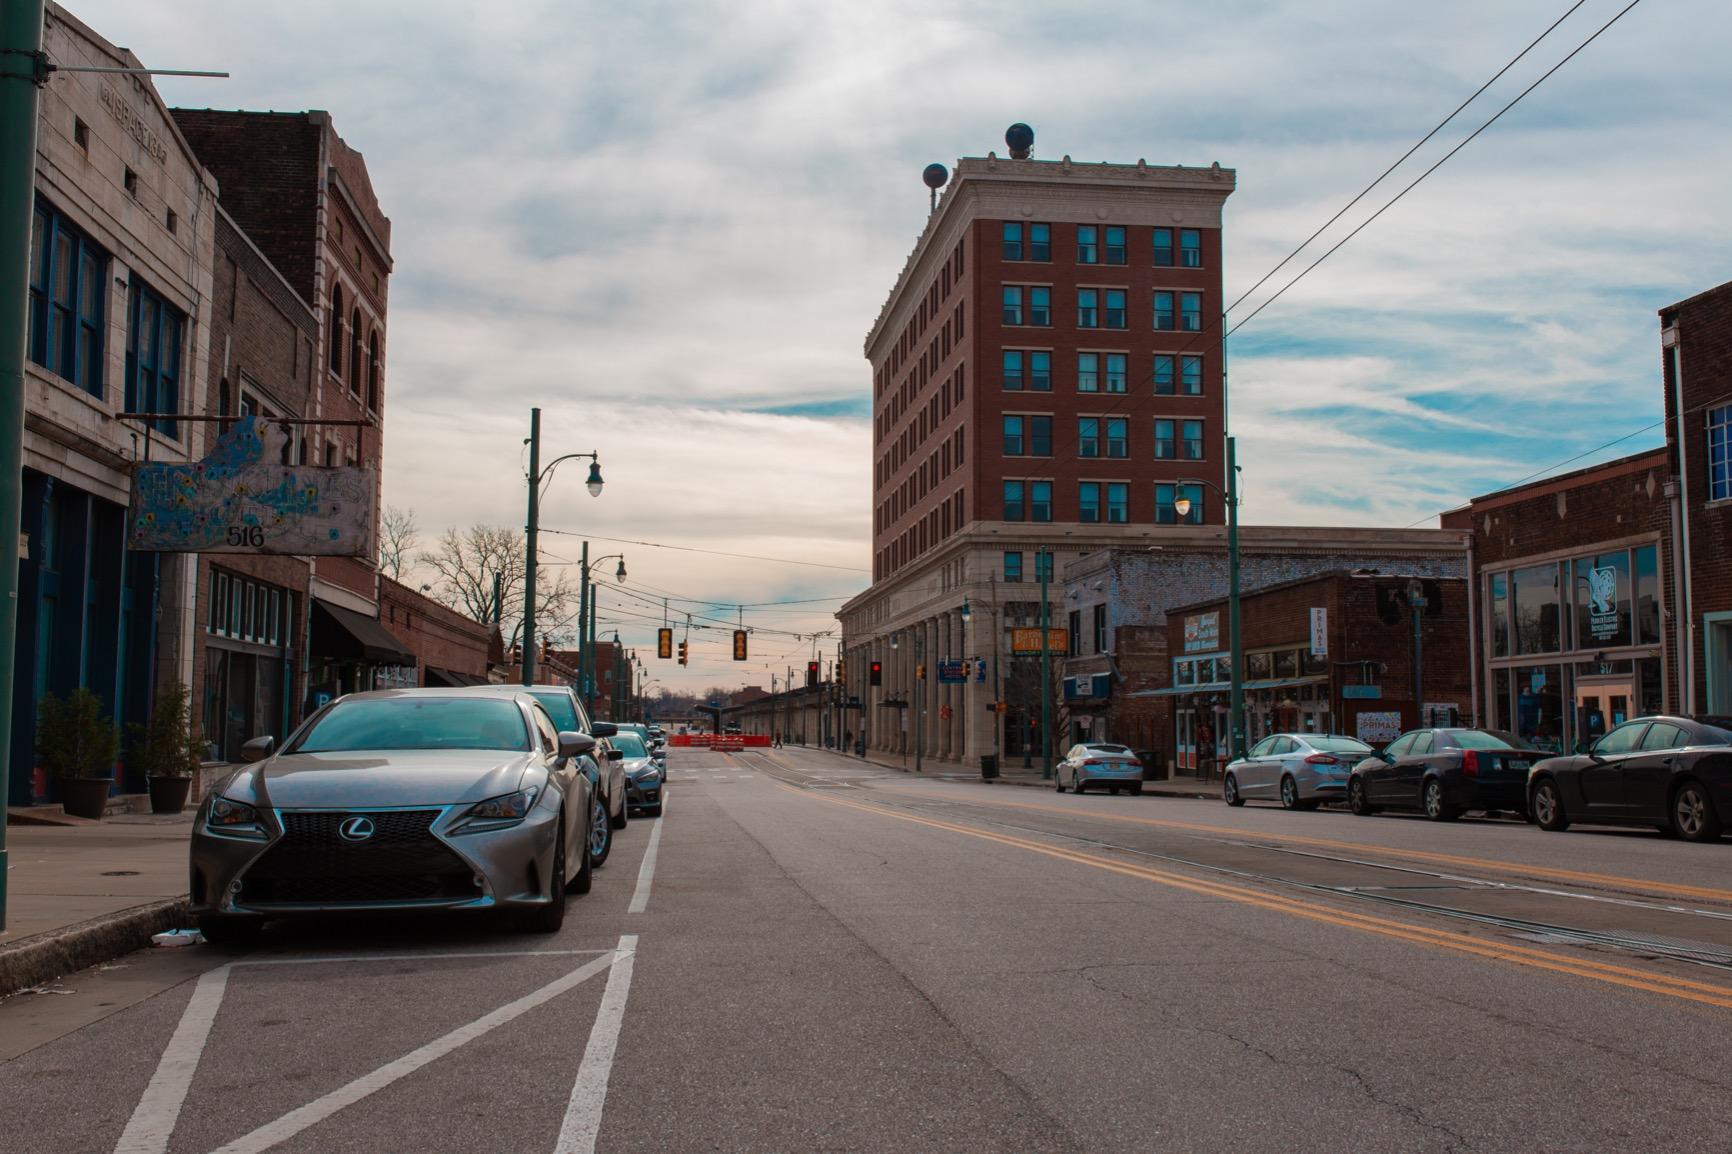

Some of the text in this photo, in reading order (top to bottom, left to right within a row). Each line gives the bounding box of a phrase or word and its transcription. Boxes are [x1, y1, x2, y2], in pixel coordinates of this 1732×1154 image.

[227, 526, 264, 547] 516
[1316, 609, 1324, 647] PRIMAS
[1600, 662, 1613, 674] 517
[319, 694, 329, 707] P
[1363, 721, 1396, 729] PRIMAS
[1591, 715, 1597, 727] P
